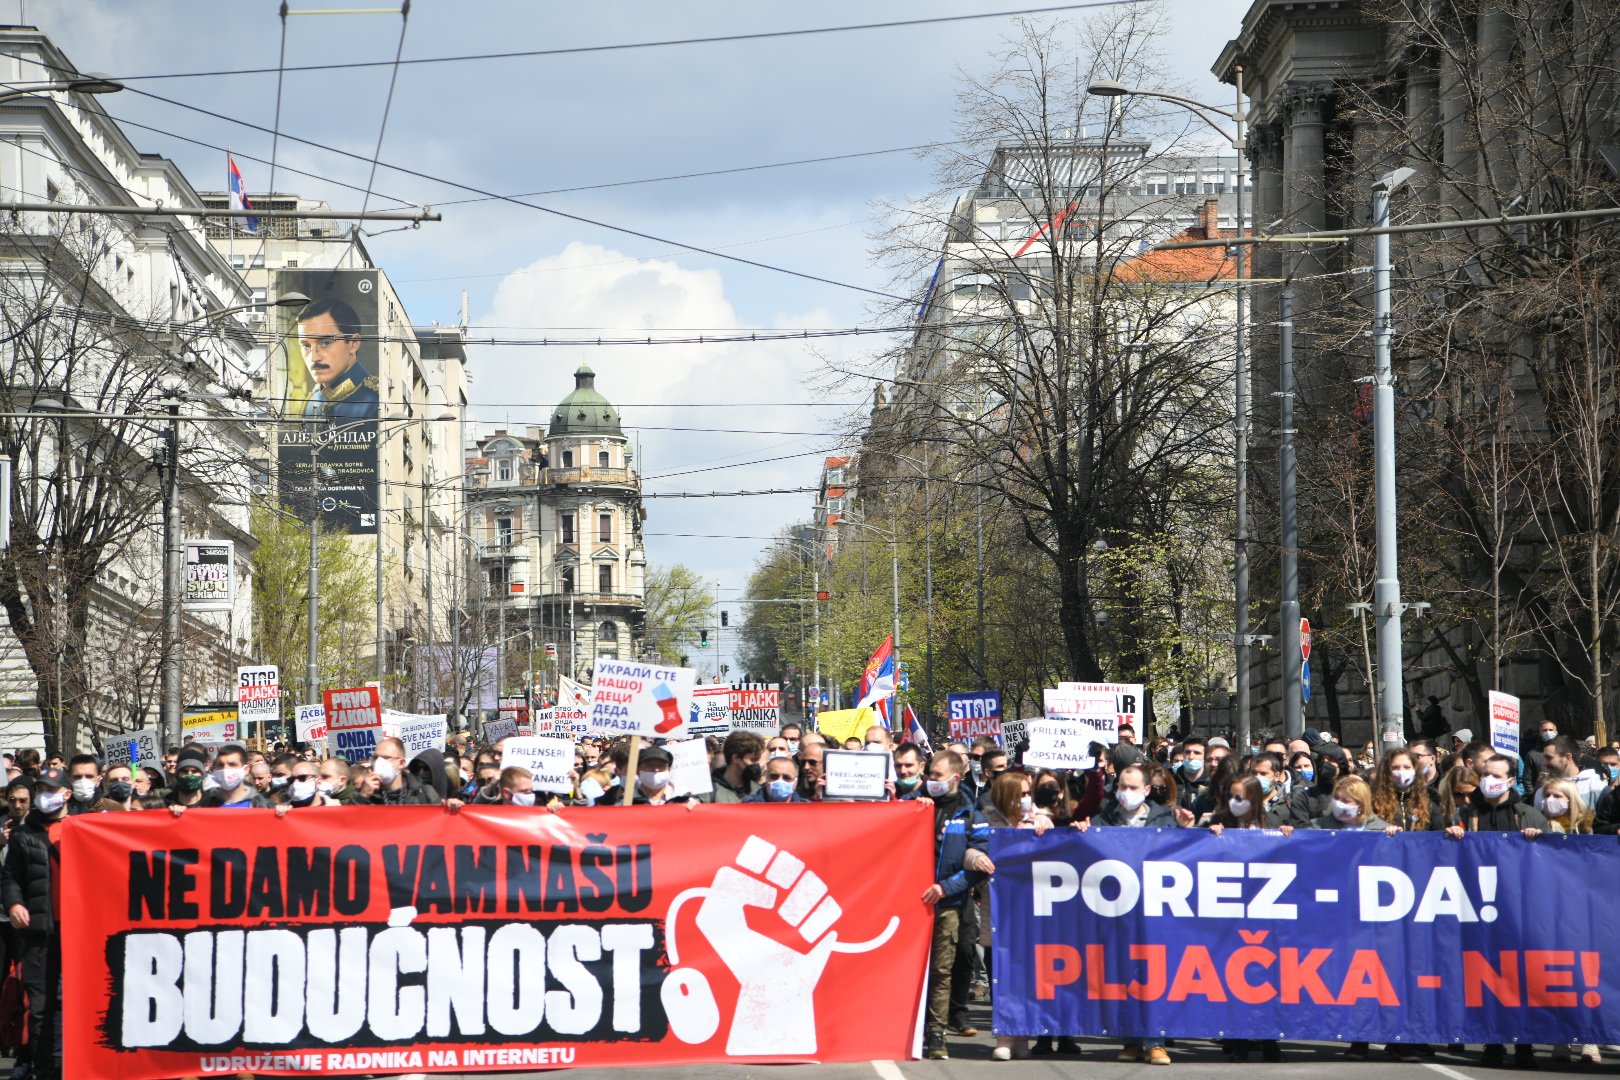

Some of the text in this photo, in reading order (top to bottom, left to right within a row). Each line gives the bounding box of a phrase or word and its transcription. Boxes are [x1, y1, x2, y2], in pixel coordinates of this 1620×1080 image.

[240, 671, 276, 687] STOP
[655, 670, 677, 681] СТЕ
[597, 677, 643, 693] НАШОЈ
[241, 697, 277, 710] RADNIKA
[331, 691, 371, 709] PRVO
[594, 690, 633, 704] ДЕЦИ
[554, 711, 587, 719] ЗАКОН
[593, 703, 629, 718] ДЕДА
[732, 708, 777, 721] RADNIKA
[951, 698, 997, 720] STOP
[329, 707, 378, 728] ZAKON
[592, 717, 641, 731] МРАЗА!
[732, 719, 777, 729] NA INTERNETU!
[1003, 722, 1025, 733] NIKO
[337, 729, 376, 749] ONDA
[402, 727, 442, 744] SVE NAŠE
[1005, 733, 1018, 743] NE
[411, 740, 432, 751] DECE
[1053, 739, 1066, 748] ZA
[107, 746, 138, 759] PORE
[108, 751, 156, 767] PREPSAO,
[511, 747, 566, 757] FRILENSERI
[1031, 751, 1088, 762] OPSTANAK!
[531, 760, 544, 769] ZA
[829, 771, 881, 779] FREELANCING
[128, 833, 652, 921] NE DAMO VAM NAŠU
[1031, 859, 1499, 923] POREZ - DA!
[1034, 930, 1602, 1009] PLJAČKA - NE!
[121, 906, 654, 1048] BUDUĆNOST
[200, 1047, 576, 1073] UDRUŽENJE RADNIKA NA INTERNETU
